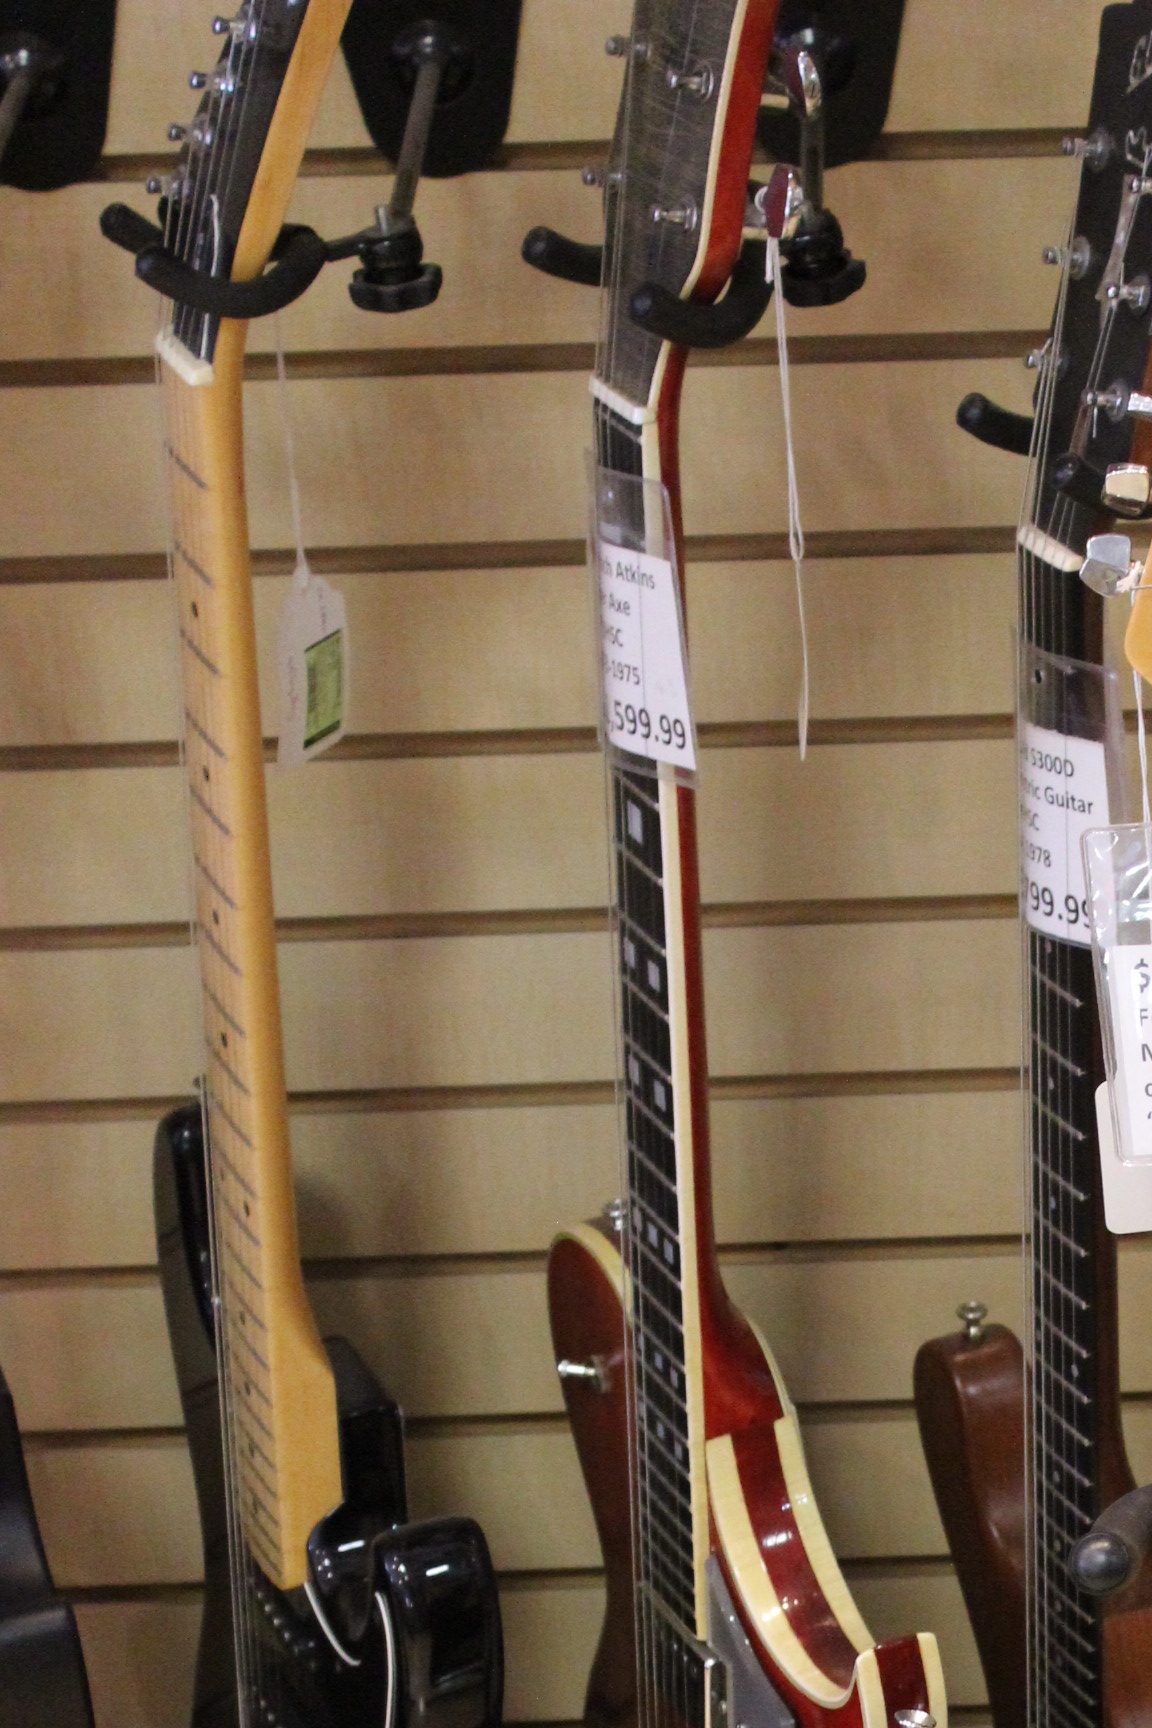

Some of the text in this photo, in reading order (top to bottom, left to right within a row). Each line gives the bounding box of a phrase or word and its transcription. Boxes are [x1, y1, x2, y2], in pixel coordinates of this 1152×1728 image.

[616, 560, 655, 589] Atkins
[608, 592, 631, 617] Axe
[1044, 786, 1094, 815] Guitar
